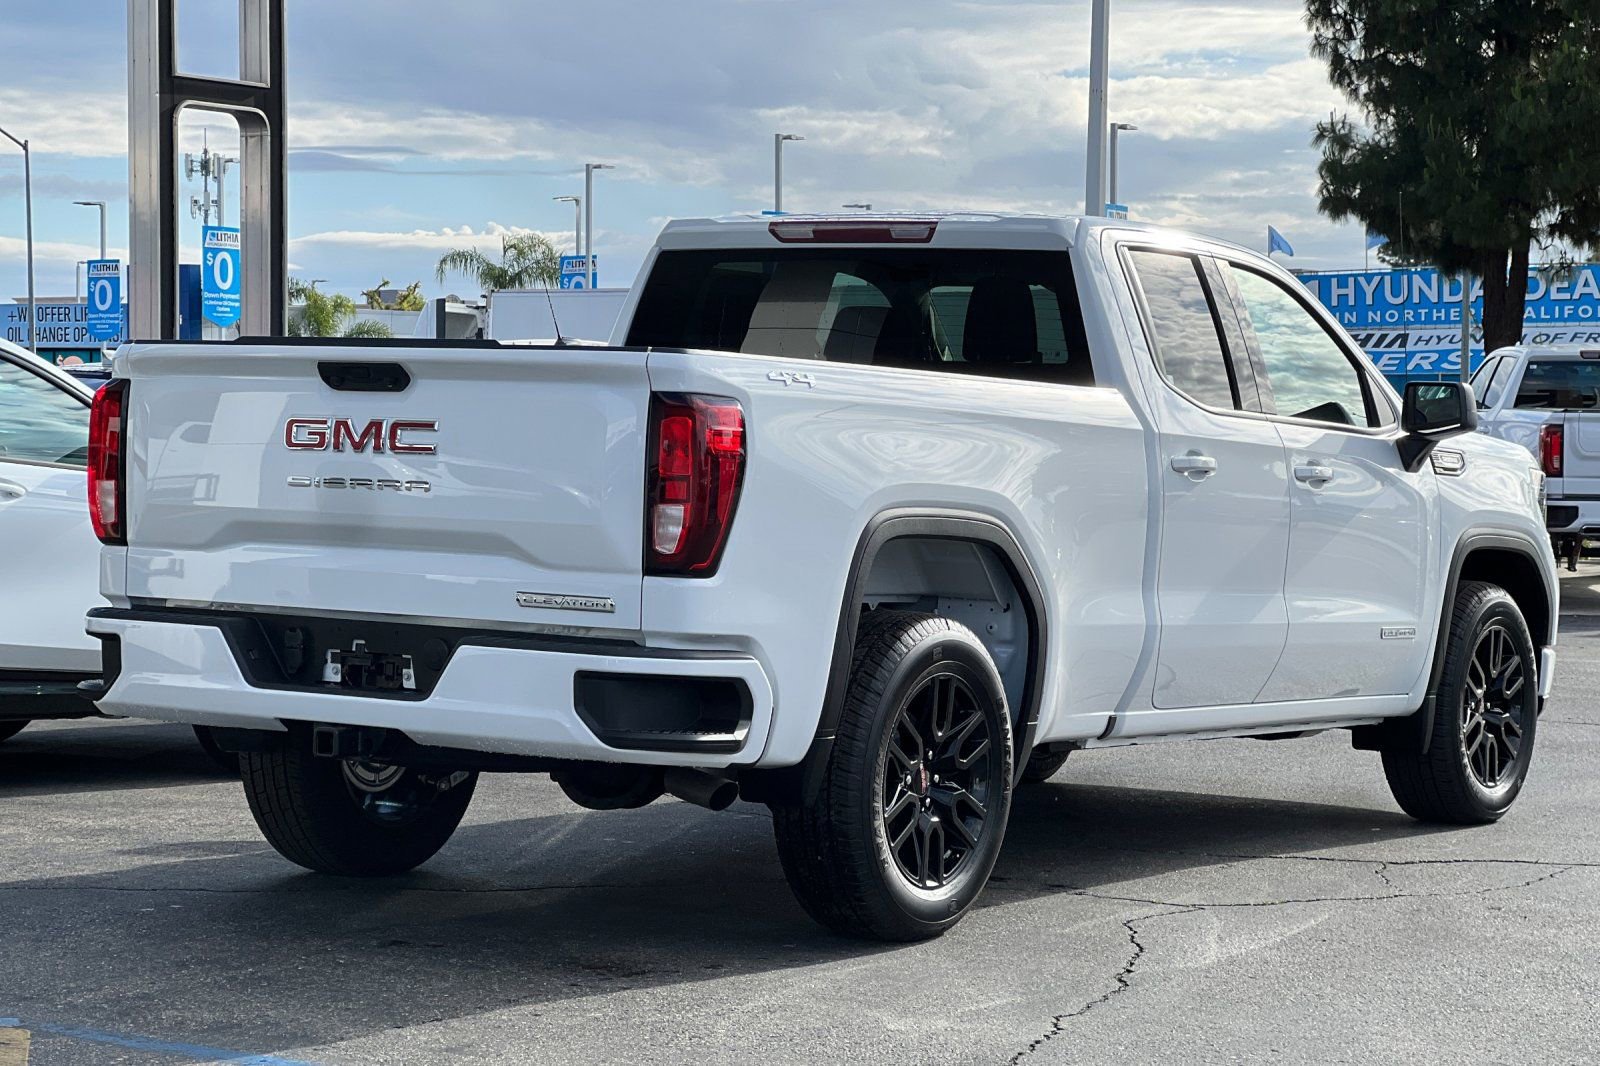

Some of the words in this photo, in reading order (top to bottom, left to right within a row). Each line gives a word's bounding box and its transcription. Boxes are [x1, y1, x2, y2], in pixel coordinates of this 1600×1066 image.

[216, 232, 239, 243] LITHIA
[96, 264, 119, 272] LITHIA
[571, 260, 596, 268] LITHA
[1331, 273, 1484, 307] HYUNDA
[37, 306, 71, 322] OFFER
[1524, 305, 1600, 319] ALIFO
[7, 327, 24, 342] OIL
[27, 327, 71, 342] HANGE
[1351, 333, 1409, 349] HIA
[1532, 332, 1567, 344] OF
[283, 416, 439, 455] GMC
[286, 476, 432, 493] SIERRA
[522, 595, 607, 609] ELEVATION
